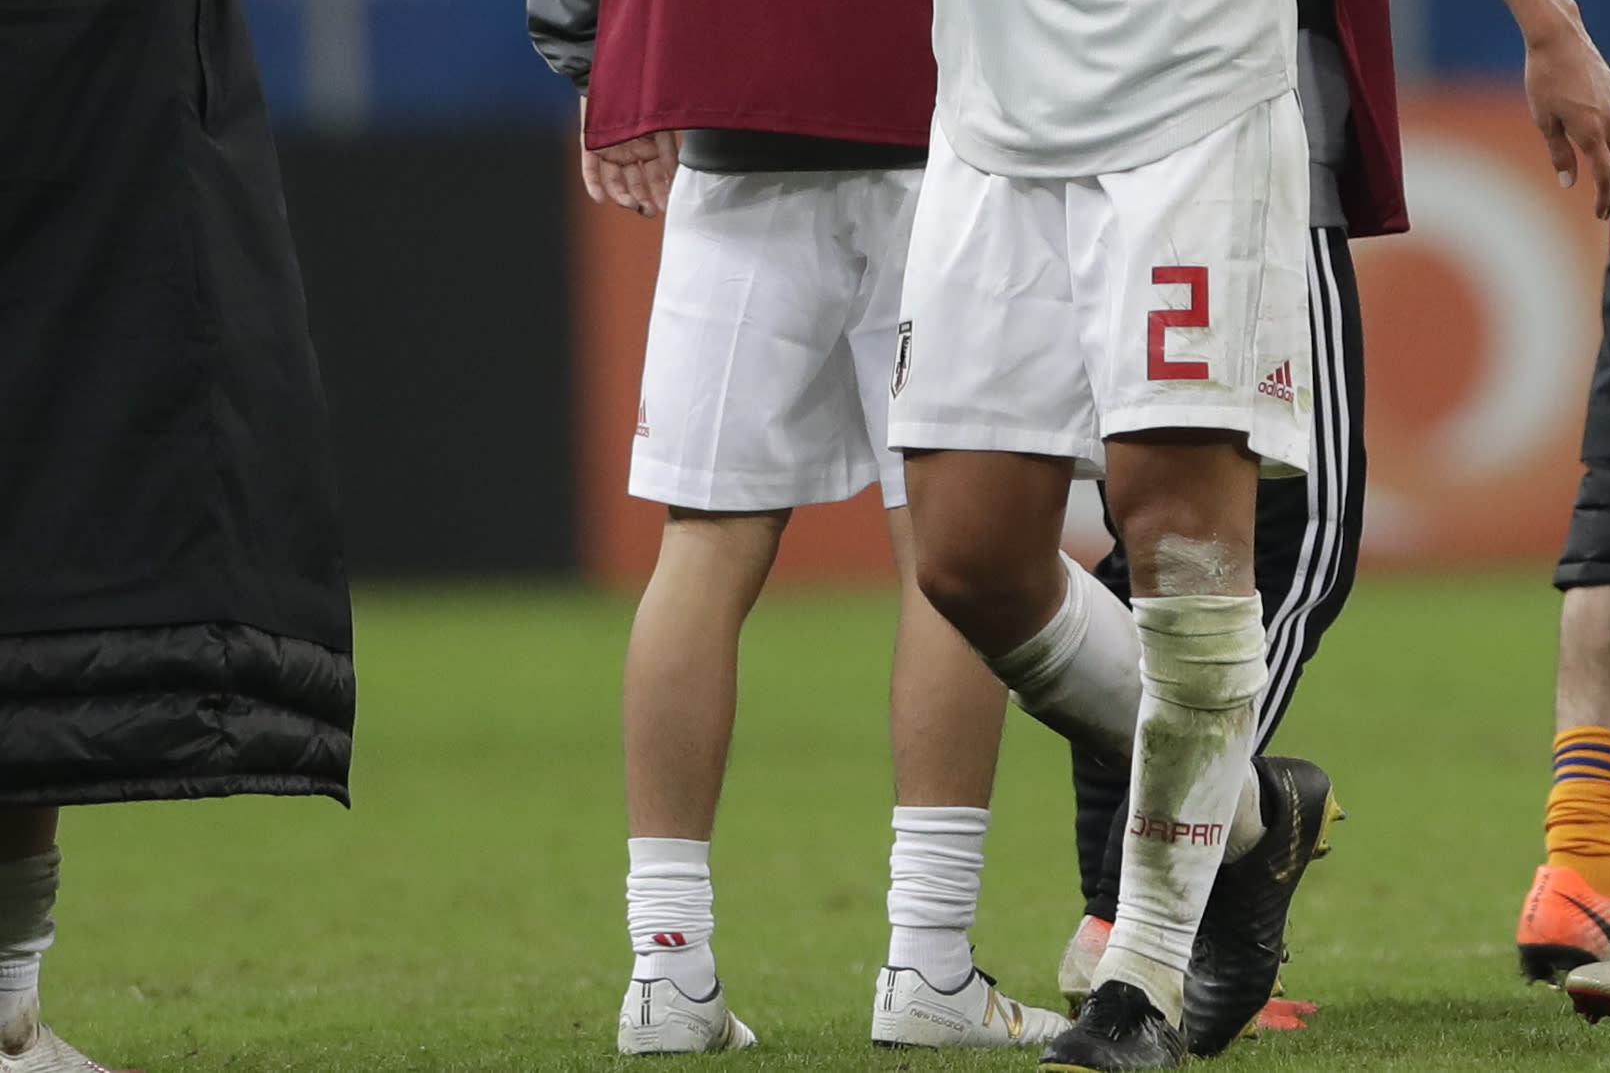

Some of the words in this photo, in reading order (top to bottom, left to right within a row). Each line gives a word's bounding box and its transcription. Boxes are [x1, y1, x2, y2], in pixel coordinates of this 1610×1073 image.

[1146, 264, 1210, 381] 2
[1258, 381, 1294, 404] adidas
[1130, 814, 1224, 847] JAPAN
